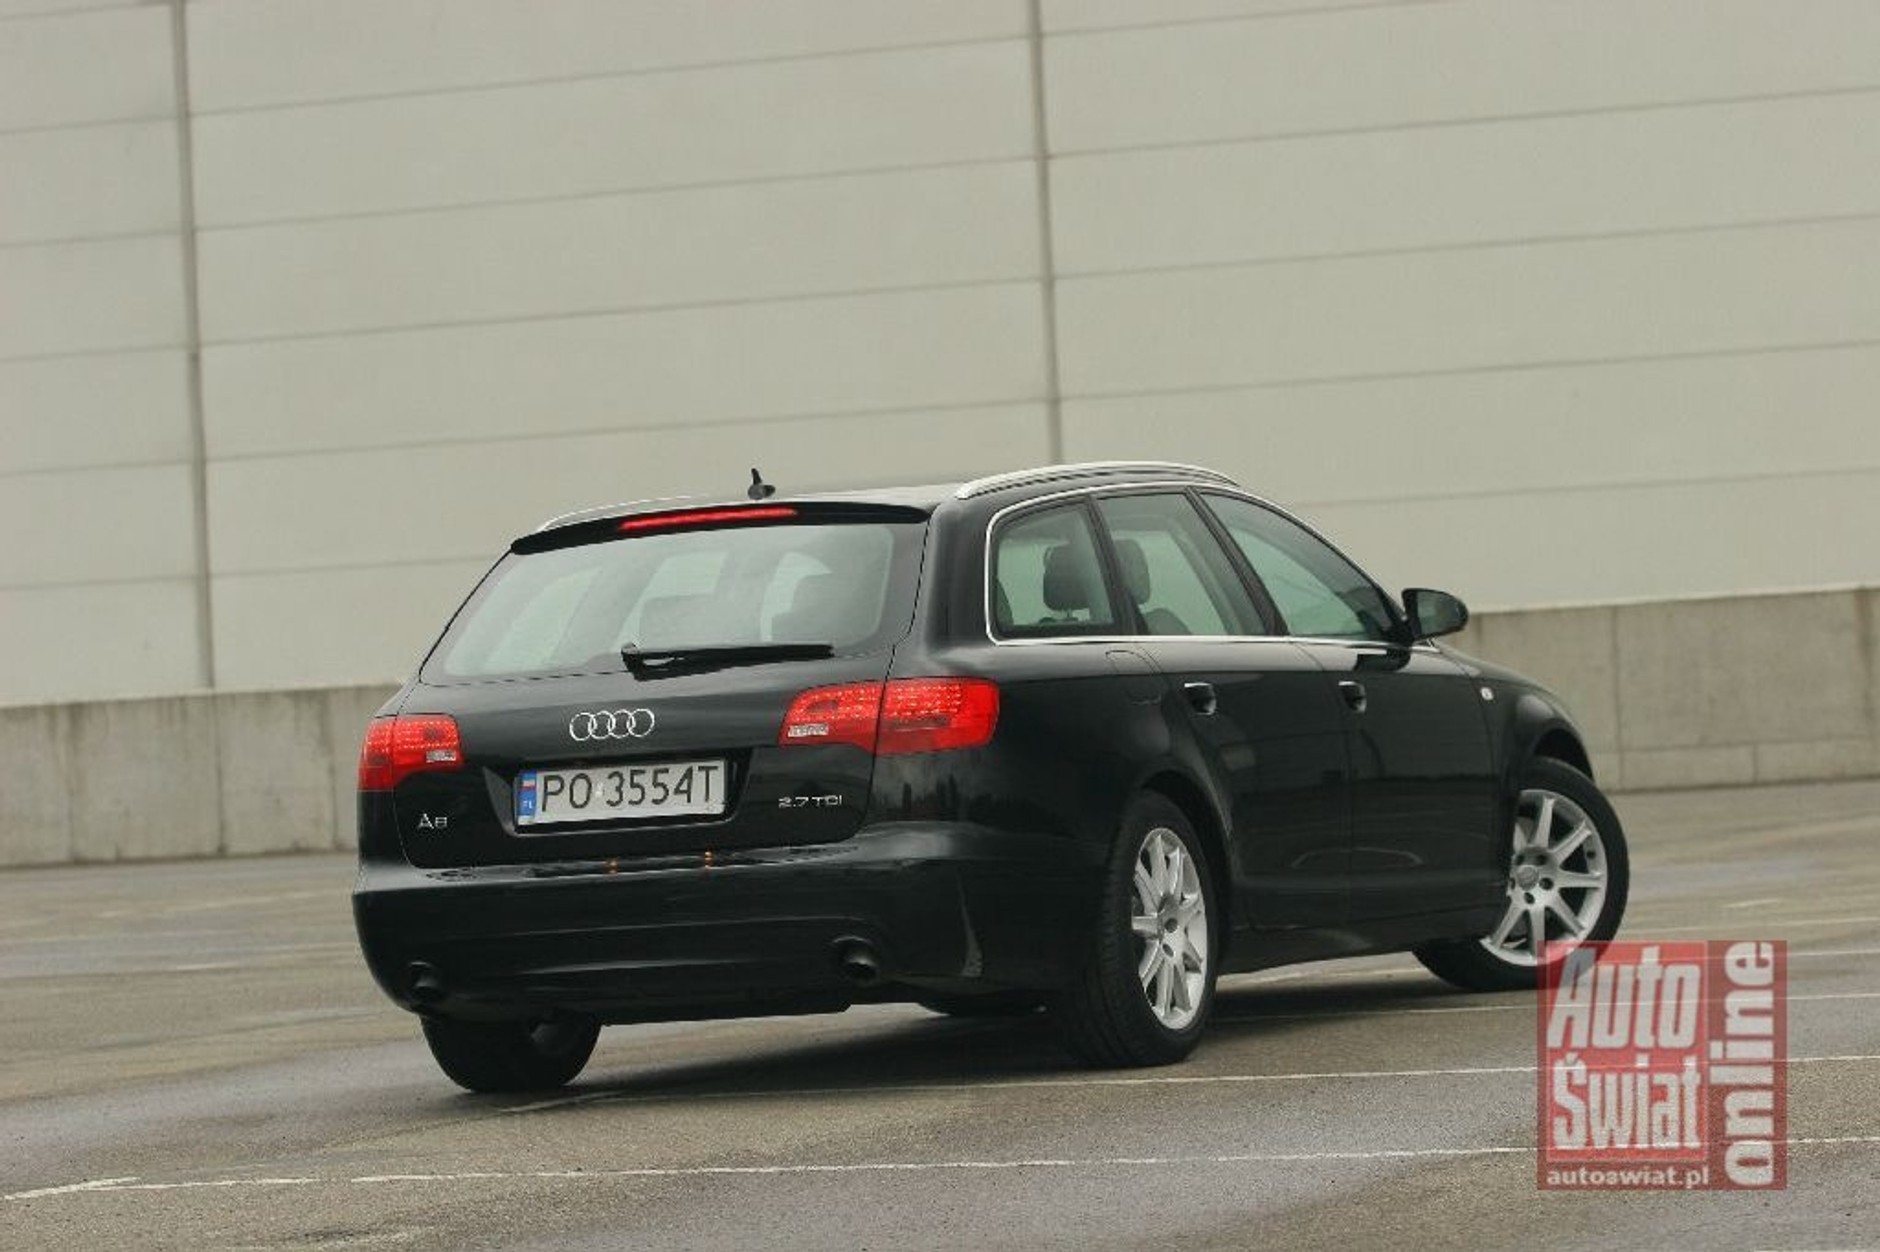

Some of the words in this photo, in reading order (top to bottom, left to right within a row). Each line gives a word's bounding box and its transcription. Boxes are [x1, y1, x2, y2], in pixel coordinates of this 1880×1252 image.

[541, 773, 592, 812] PO
[605, 765, 719, 807] 3554T
[778, 796, 809, 808] 2.7
[811, 795, 842, 807] TDI
